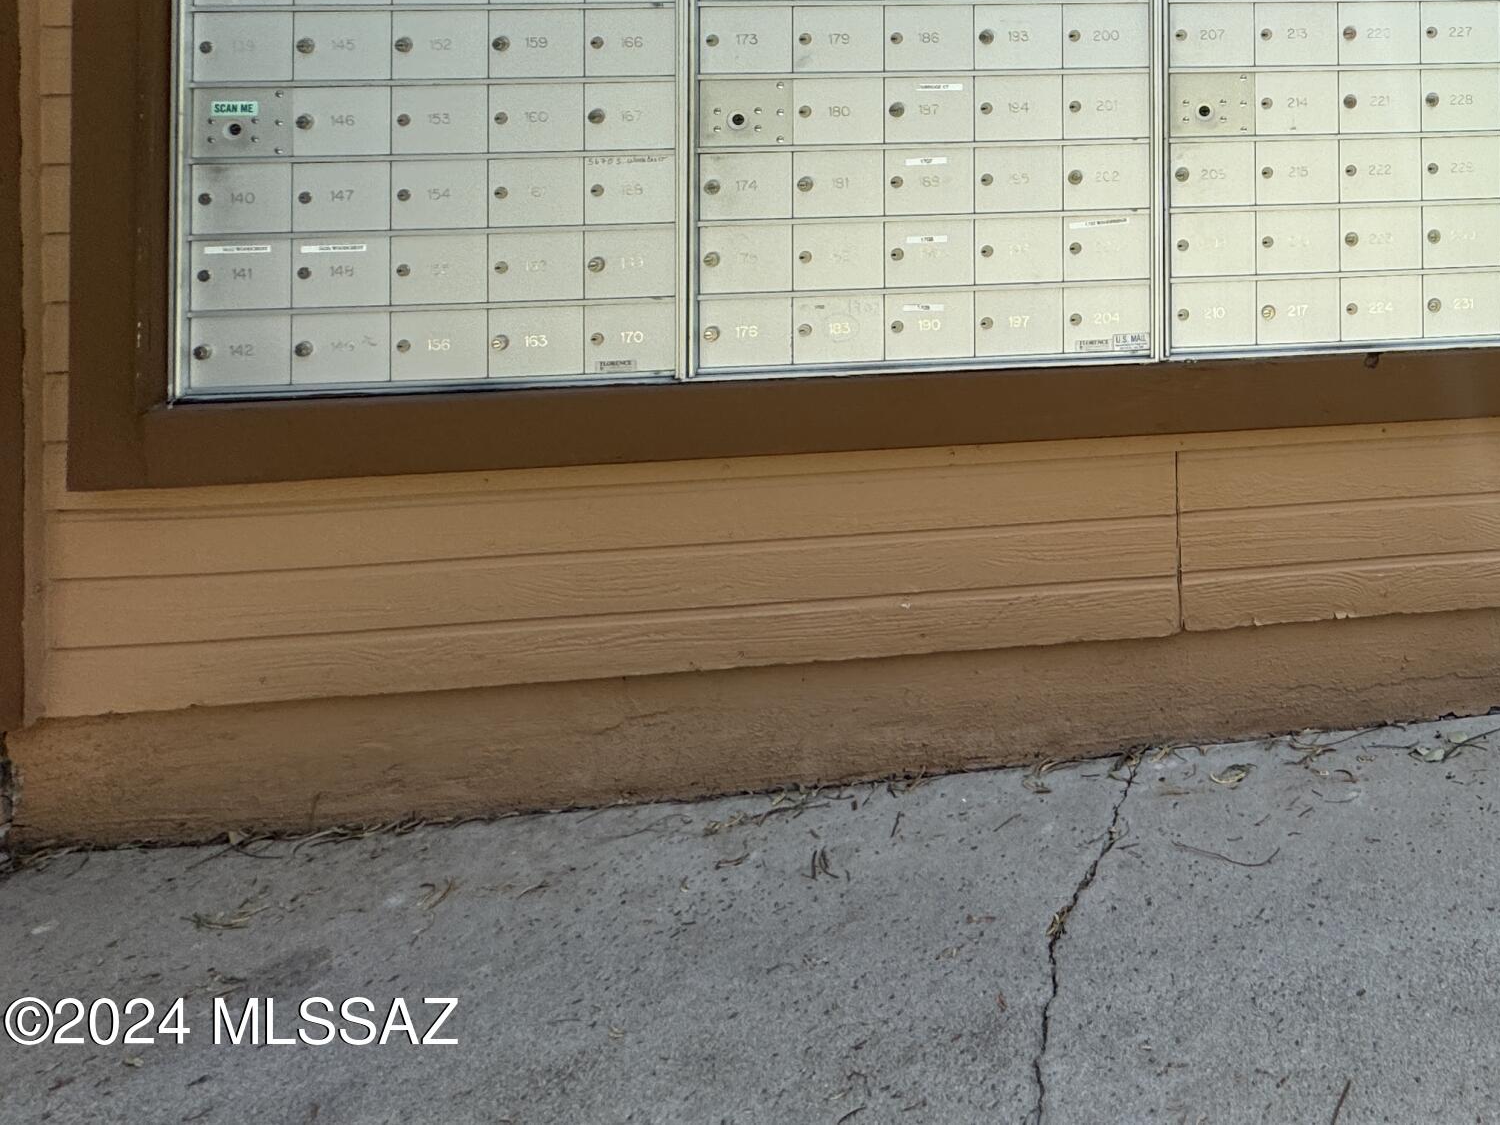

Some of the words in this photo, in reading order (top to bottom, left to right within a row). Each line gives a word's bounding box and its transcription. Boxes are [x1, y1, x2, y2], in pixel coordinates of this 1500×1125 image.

[828, 32, 851, 45] 179
[918, 32, 940, 44] 186
[1007, 30, 1030, 43] 193
[1092, 29, 1121, 42] 200
[1200, 28, 1225, 41] 207
[1448, 26, 1473, 38] 227
[331, 38, 356, 52] 145
[428, 38, 453, 51] 152
[525, 35, 548, 49] 159
[621, 35, 644, 49] 166
[736, 33, 759, 46] 173
[1096, 99, 1118, 112] 201
[1287, 97, 1308, 109] 214
[1369, 94, 1390, 107] 221
[1449, 93, 1474, 106] 228
[213, 102, 240, 114] SCAN
[240, 102, 254, 114] ME
[827, 105, 851, 118] 180
[330, 114, 356, 127] 146
[428, 112, 451, 125] 153
[621, 110, 643, 123] 167
[1368, 163, 1392, 176] 222
[735, 179, 759, 192] 174
[230, 191, 257, 205] 140
[330, 189, 355, 202] 147
[427, 187, 451, 201] 154
[232, 267, 253, 280] 141
[1368, 301, 1394, 315] 224
[1453, 297, 1475, 310] 231
[1203, 306, 1227, 320] 210
[1287, 304, 1309, 317] 217
[917, 318, 942, 331] 190
[1008, 315, 1031, 329] 197
[1093, 312, 1120, 325] 204
[620, 330, 645, 344] 170
[735, 325, 759, 338] 176
[427, 338, 451, 352] 156
[524, 334, 549, 348] 163
[1115, 335, 1128, 344] U.S.
[1130, 334, 1147, 343] MAIL
[229, 343, 254, 357] 142
